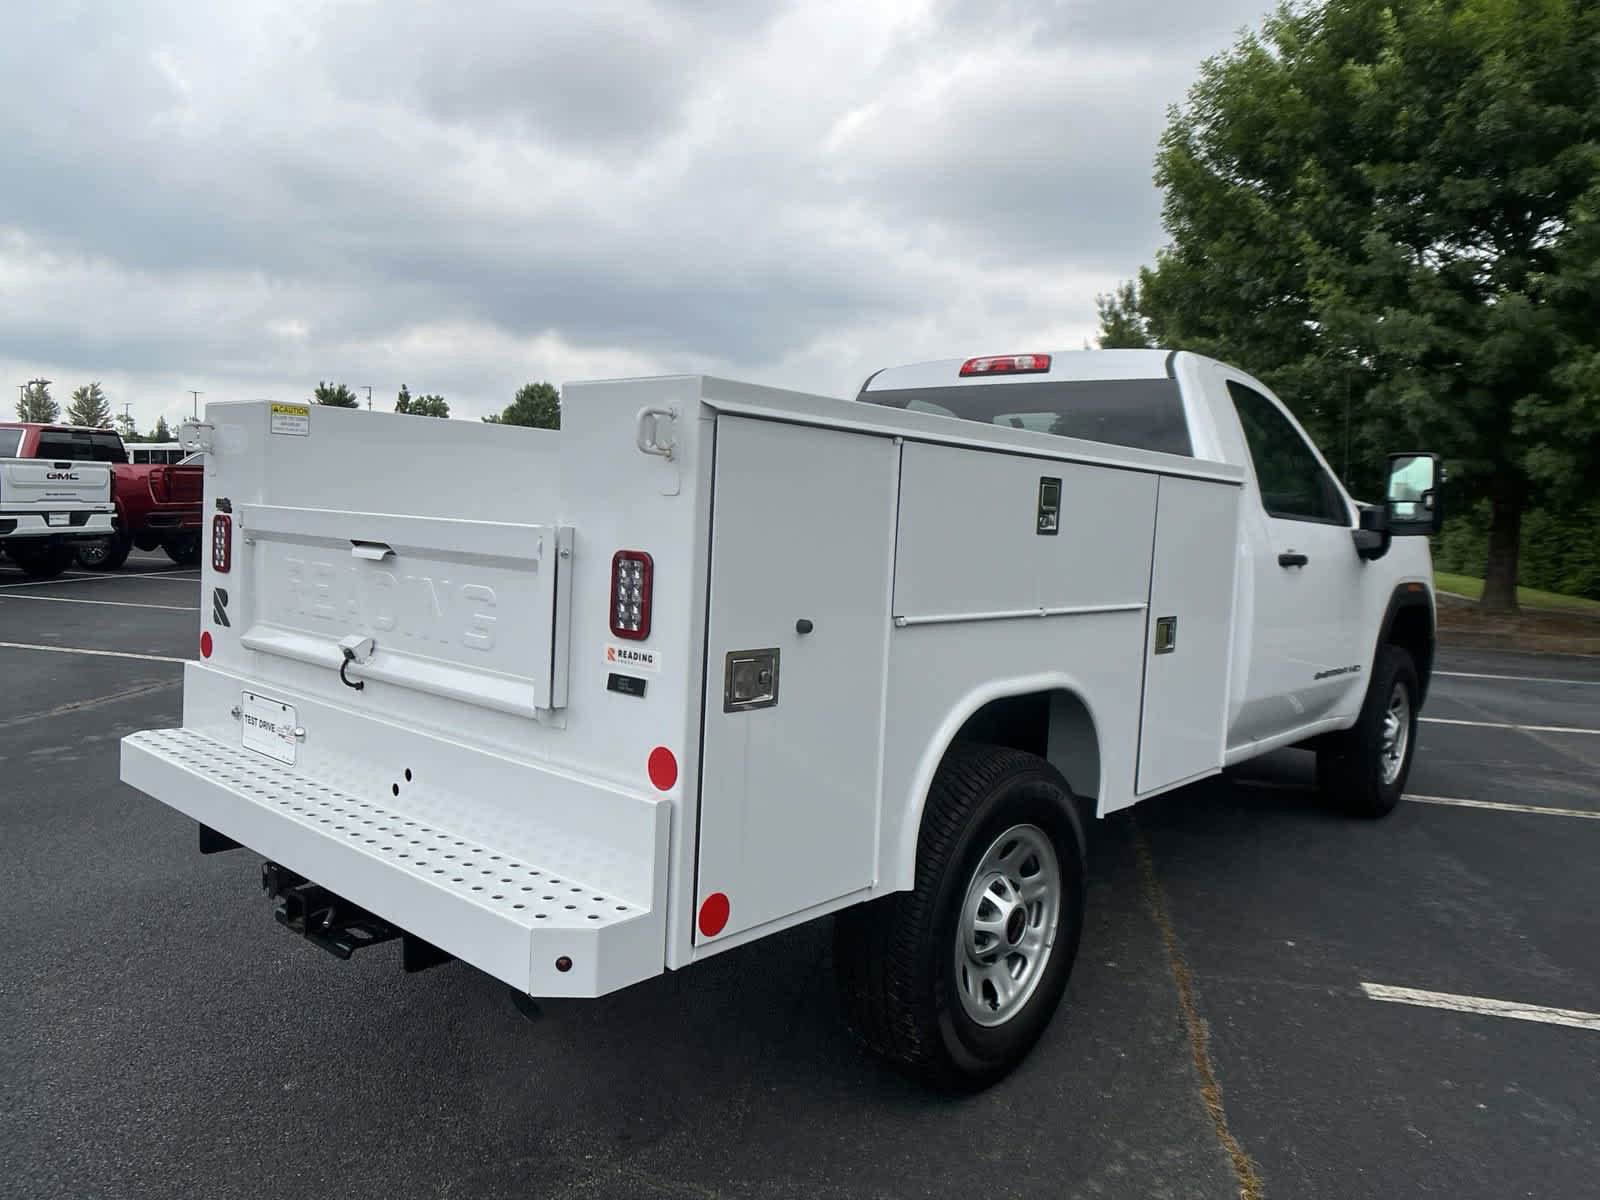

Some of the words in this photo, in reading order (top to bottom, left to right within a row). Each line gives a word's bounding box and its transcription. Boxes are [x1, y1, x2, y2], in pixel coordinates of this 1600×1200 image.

[46, 472, 80, 480] GMC
[617, 649, 653, 663] READING
[245, 713, 258, 726] TEST
[259, 719, 275, 733] DRIVE
